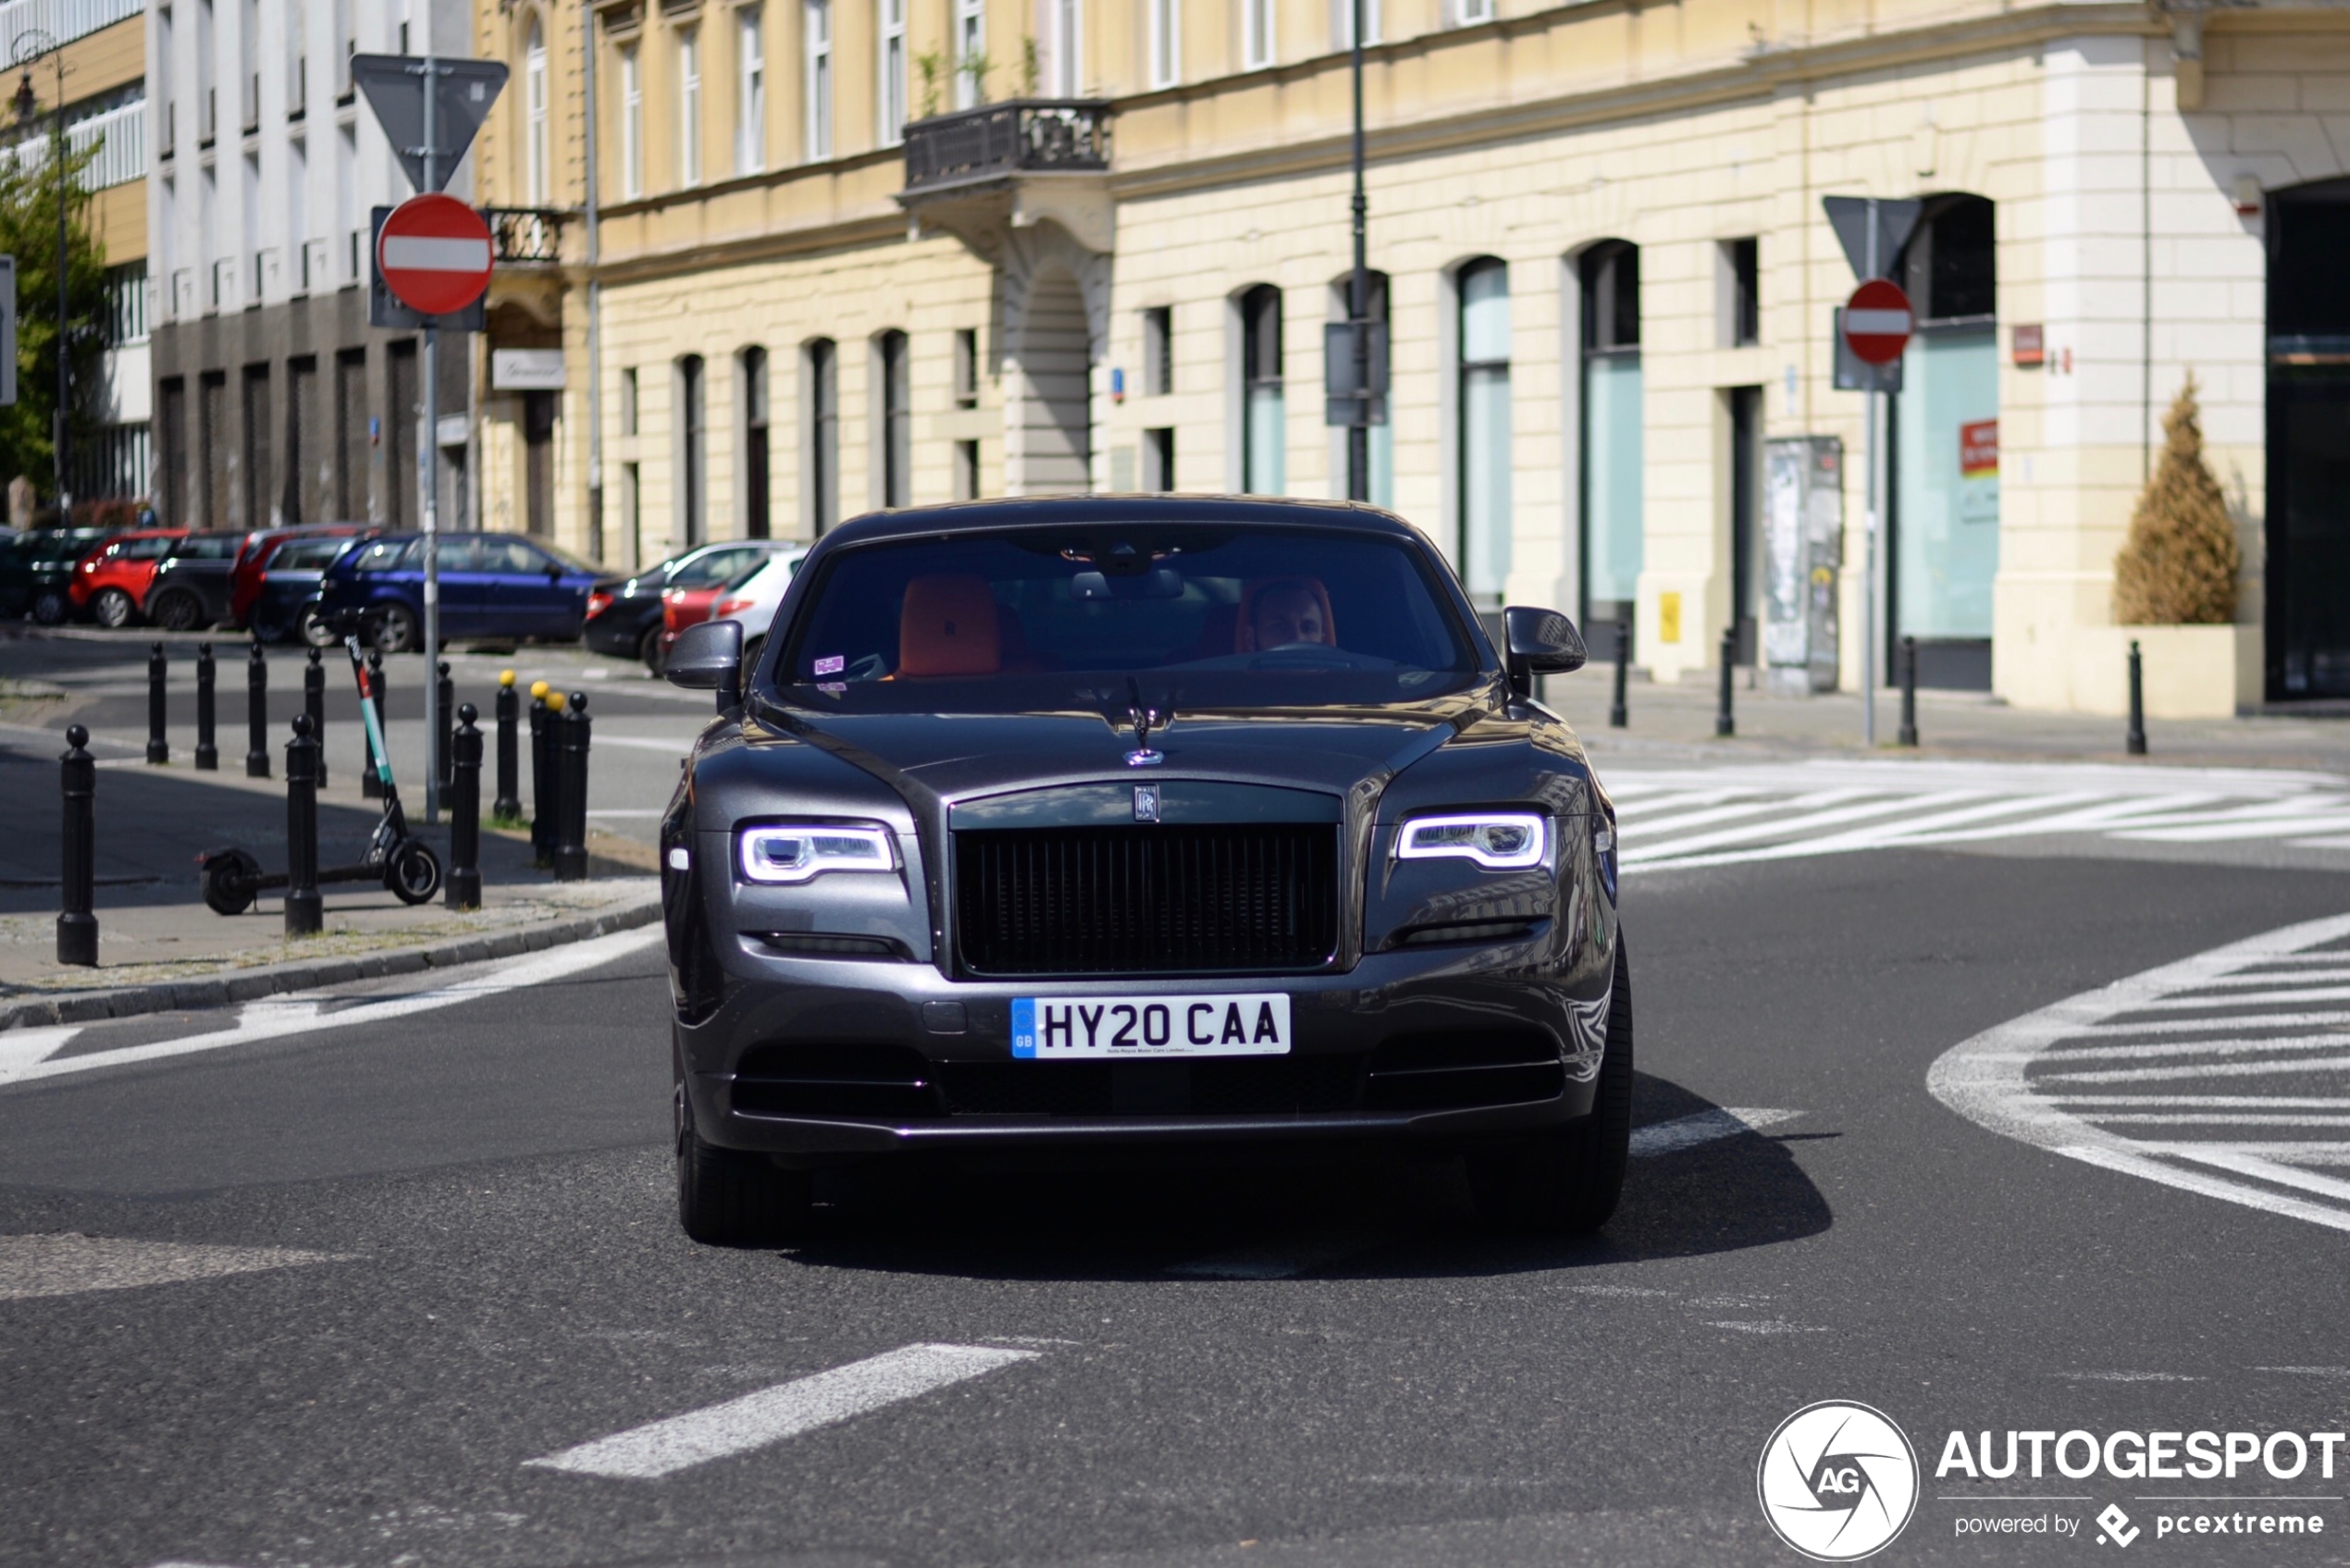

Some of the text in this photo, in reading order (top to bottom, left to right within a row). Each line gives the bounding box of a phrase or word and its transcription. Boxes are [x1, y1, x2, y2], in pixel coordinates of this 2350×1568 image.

[1045, 1001, 1280, 1047] HY20 CAA
[1016, 1035, 1033, 1047] GB
